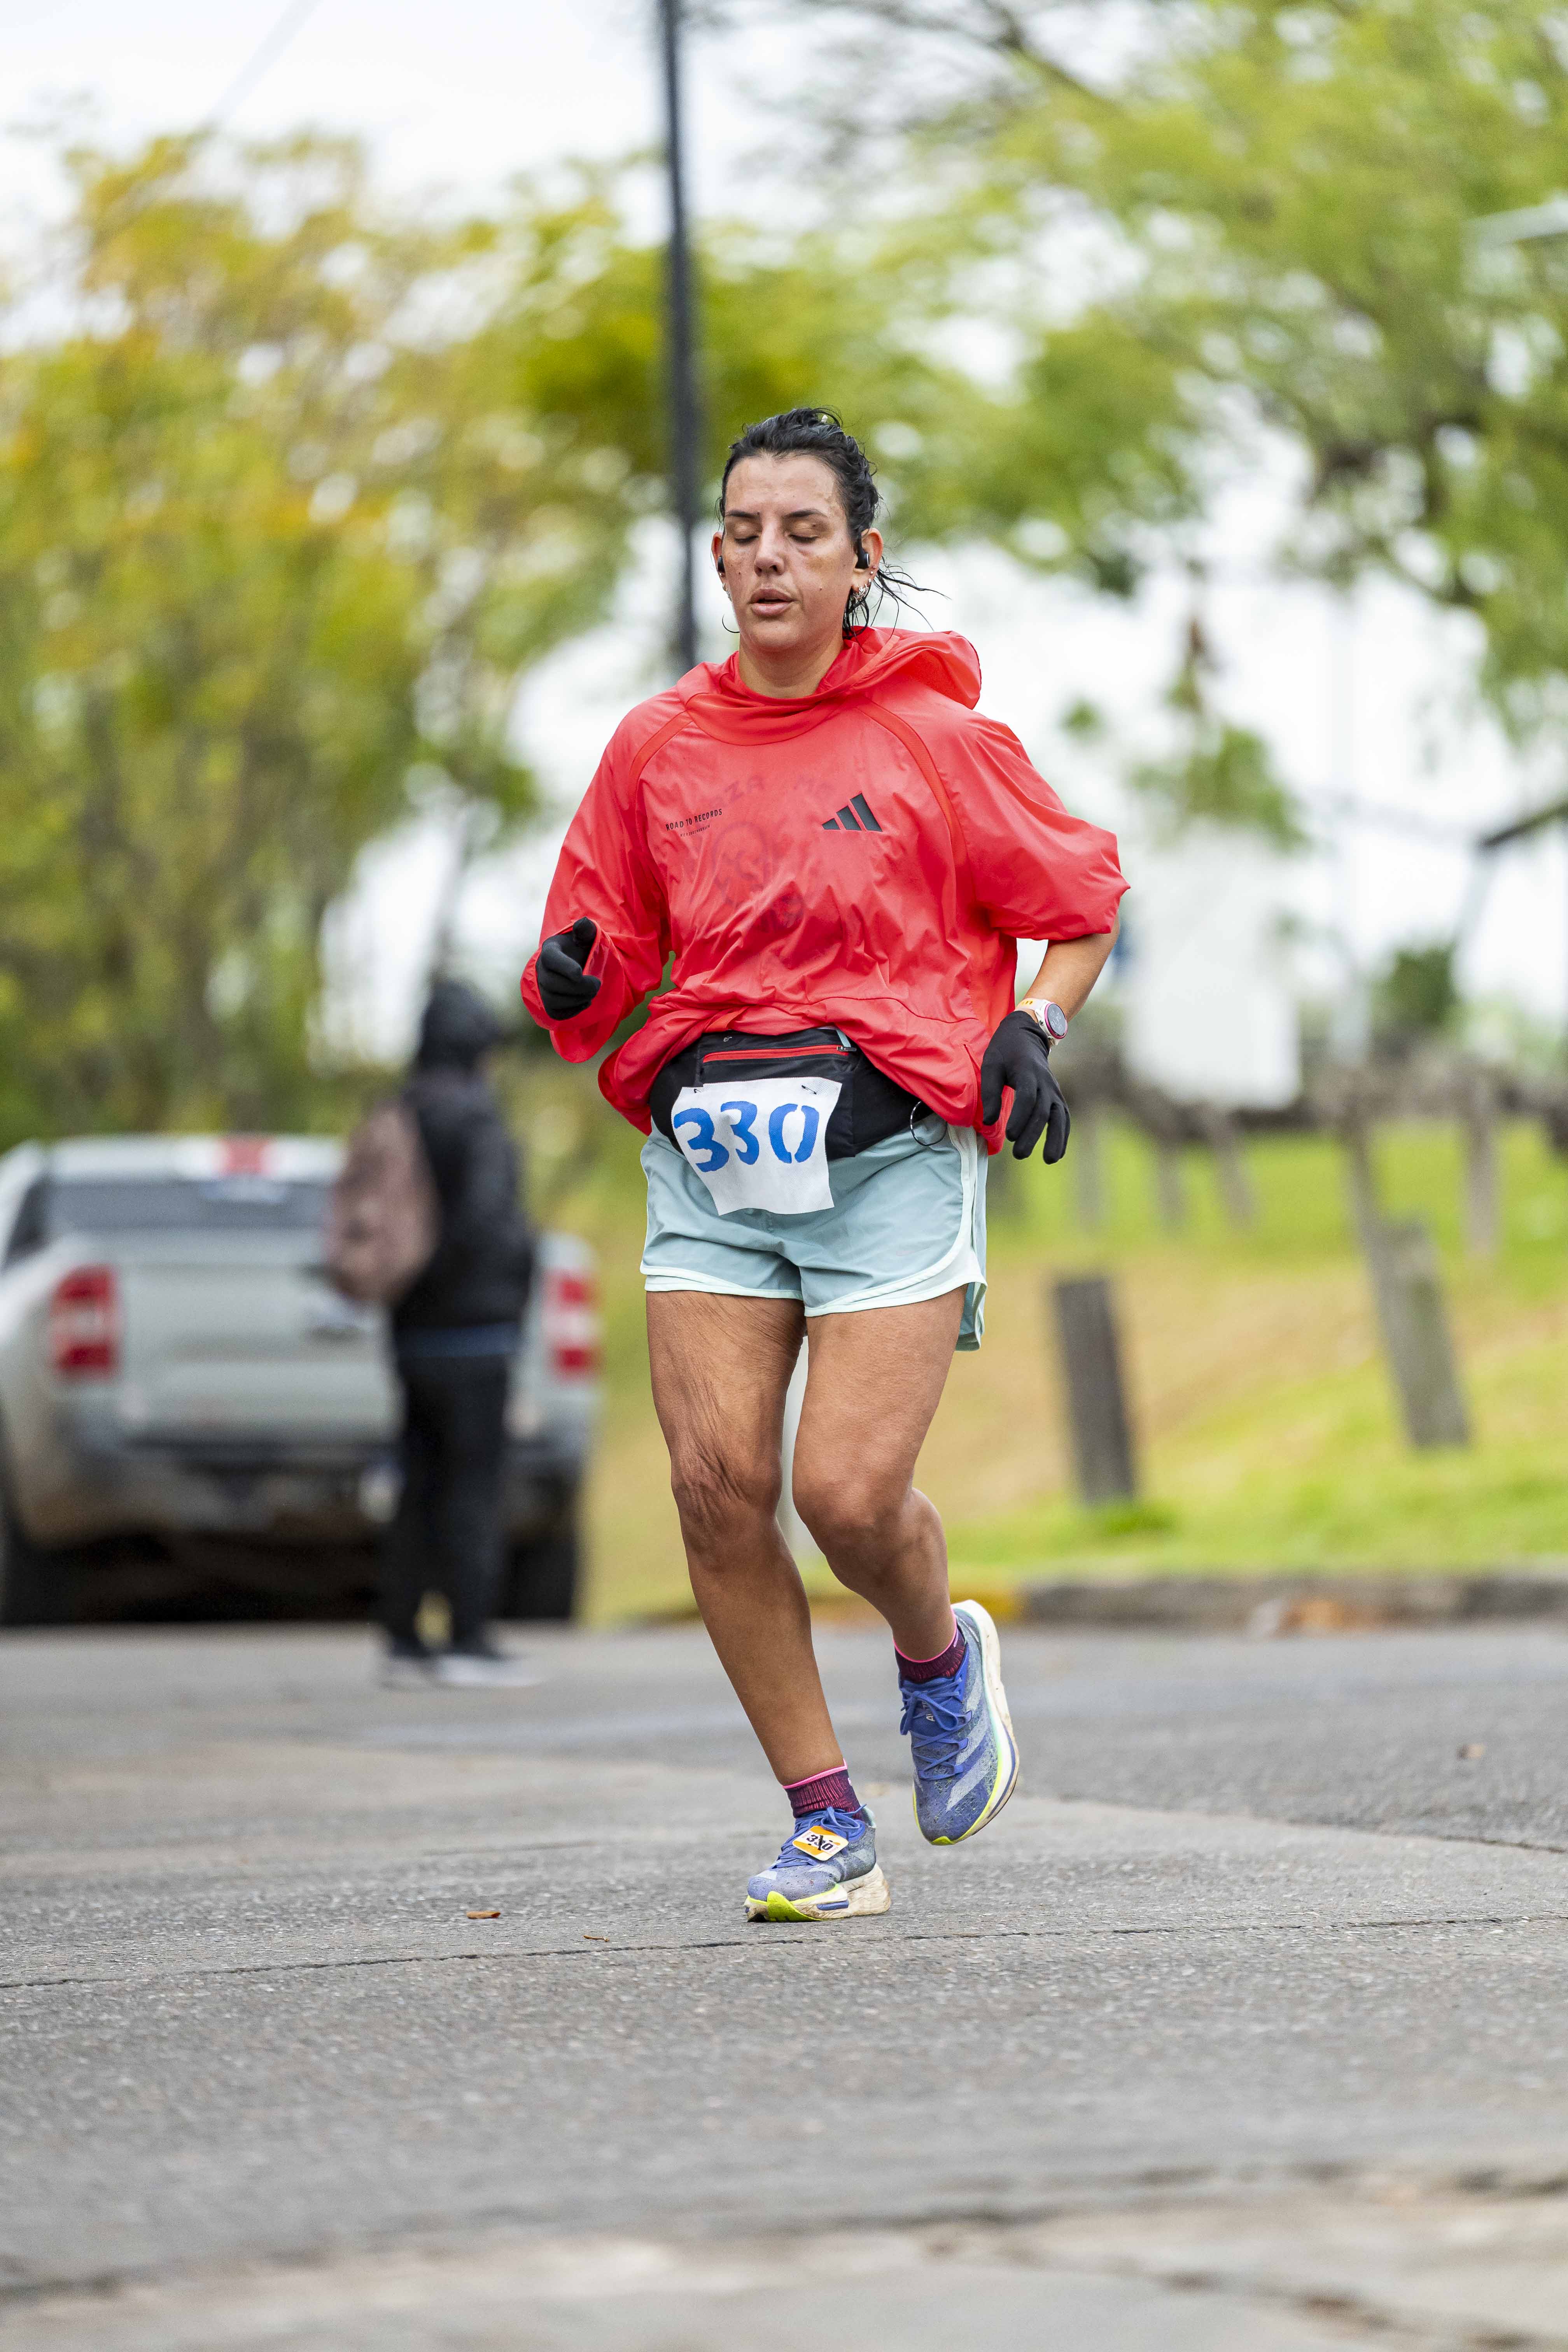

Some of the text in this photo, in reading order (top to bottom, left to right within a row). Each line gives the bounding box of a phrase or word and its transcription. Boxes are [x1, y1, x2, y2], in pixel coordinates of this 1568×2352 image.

[665, 808, 722, 831] ROAD TO RECORDS
[673, 1101, 819, 1173] 330
